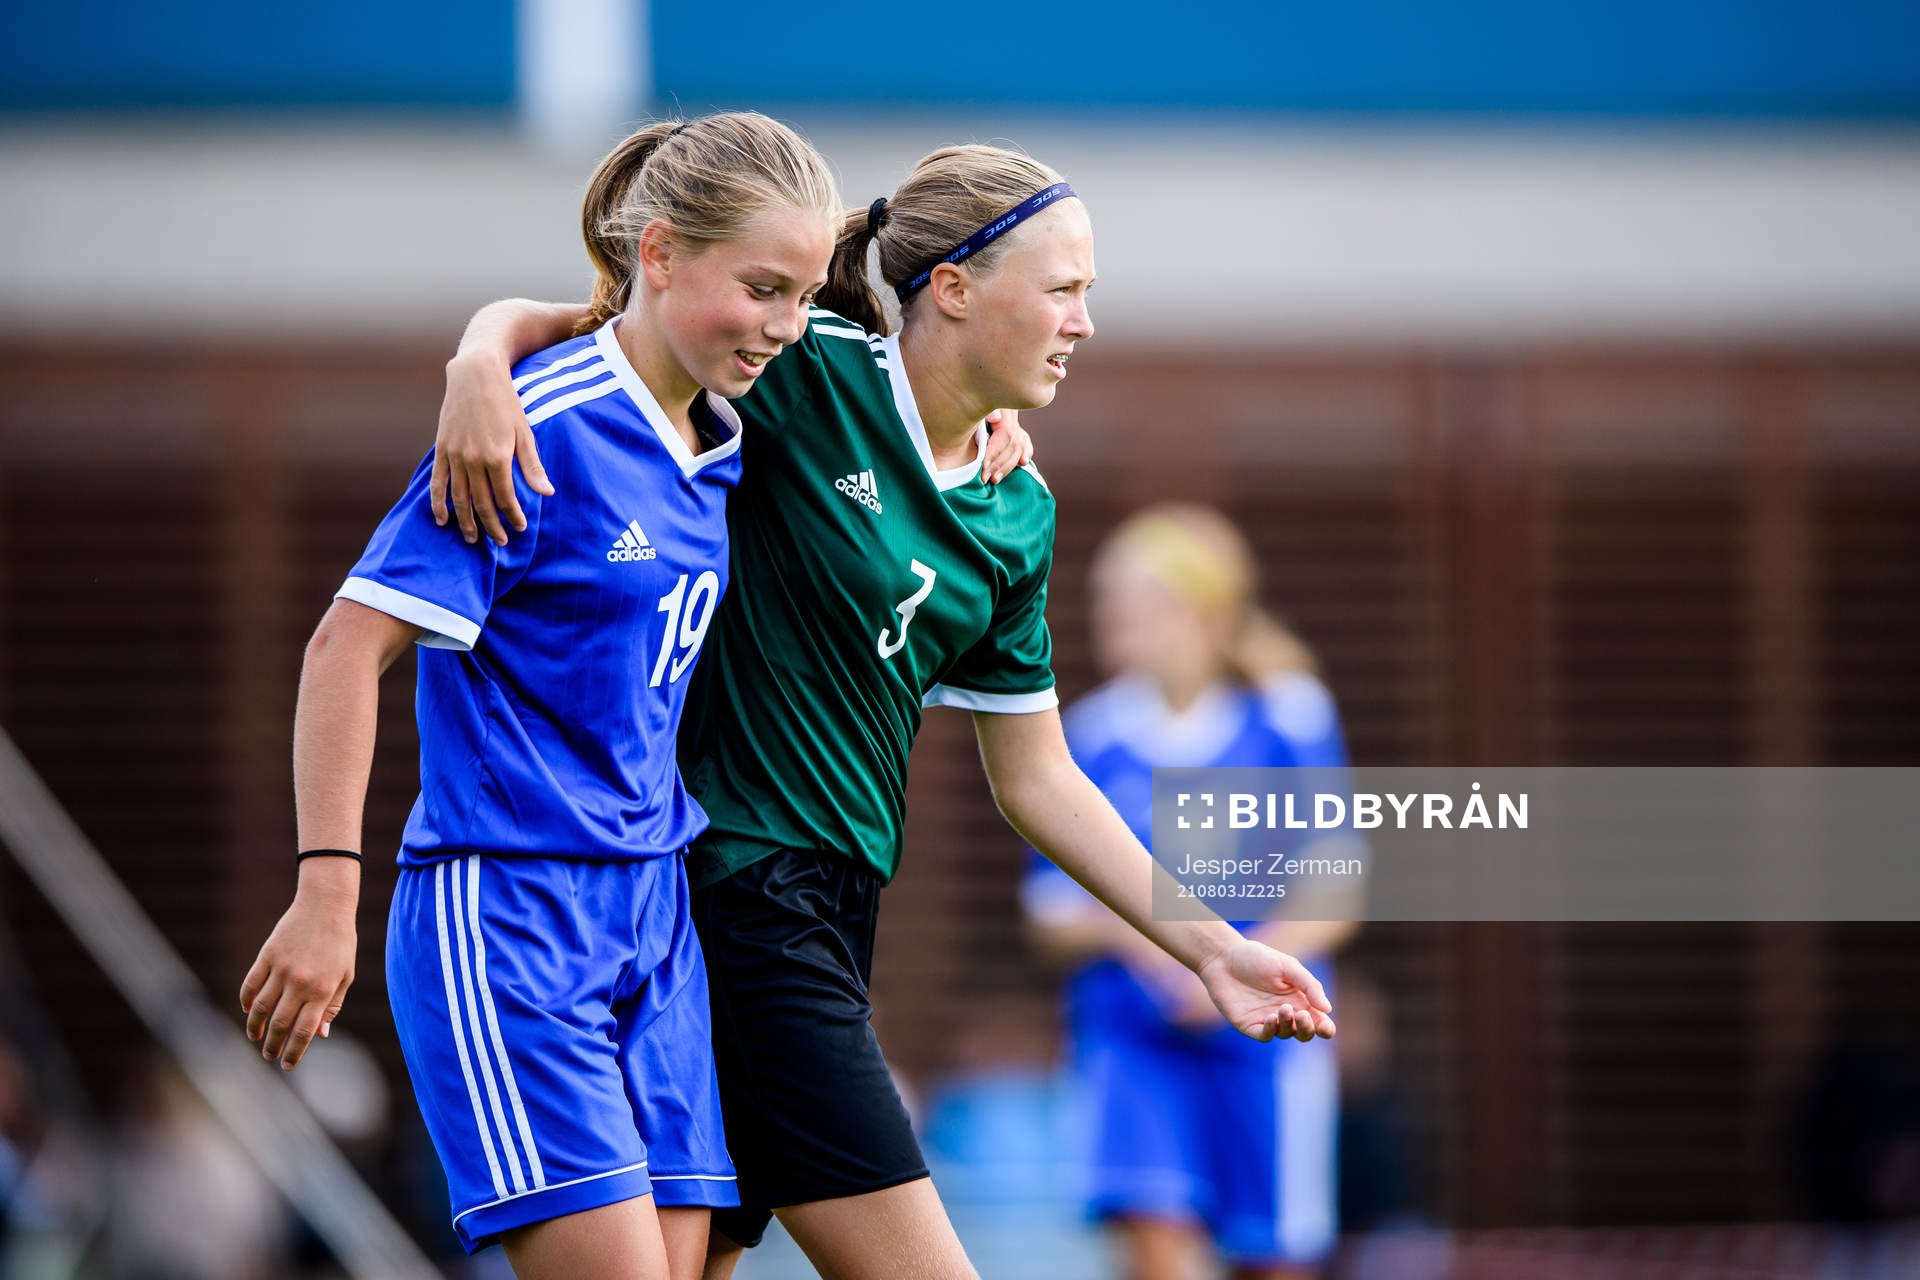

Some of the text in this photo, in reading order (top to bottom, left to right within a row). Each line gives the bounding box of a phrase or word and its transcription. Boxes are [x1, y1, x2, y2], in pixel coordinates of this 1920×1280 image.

[834, 477, 883, 516] adidas
[606, 546, 657, 563] adidas
[648, 570, 720, 689] 19
